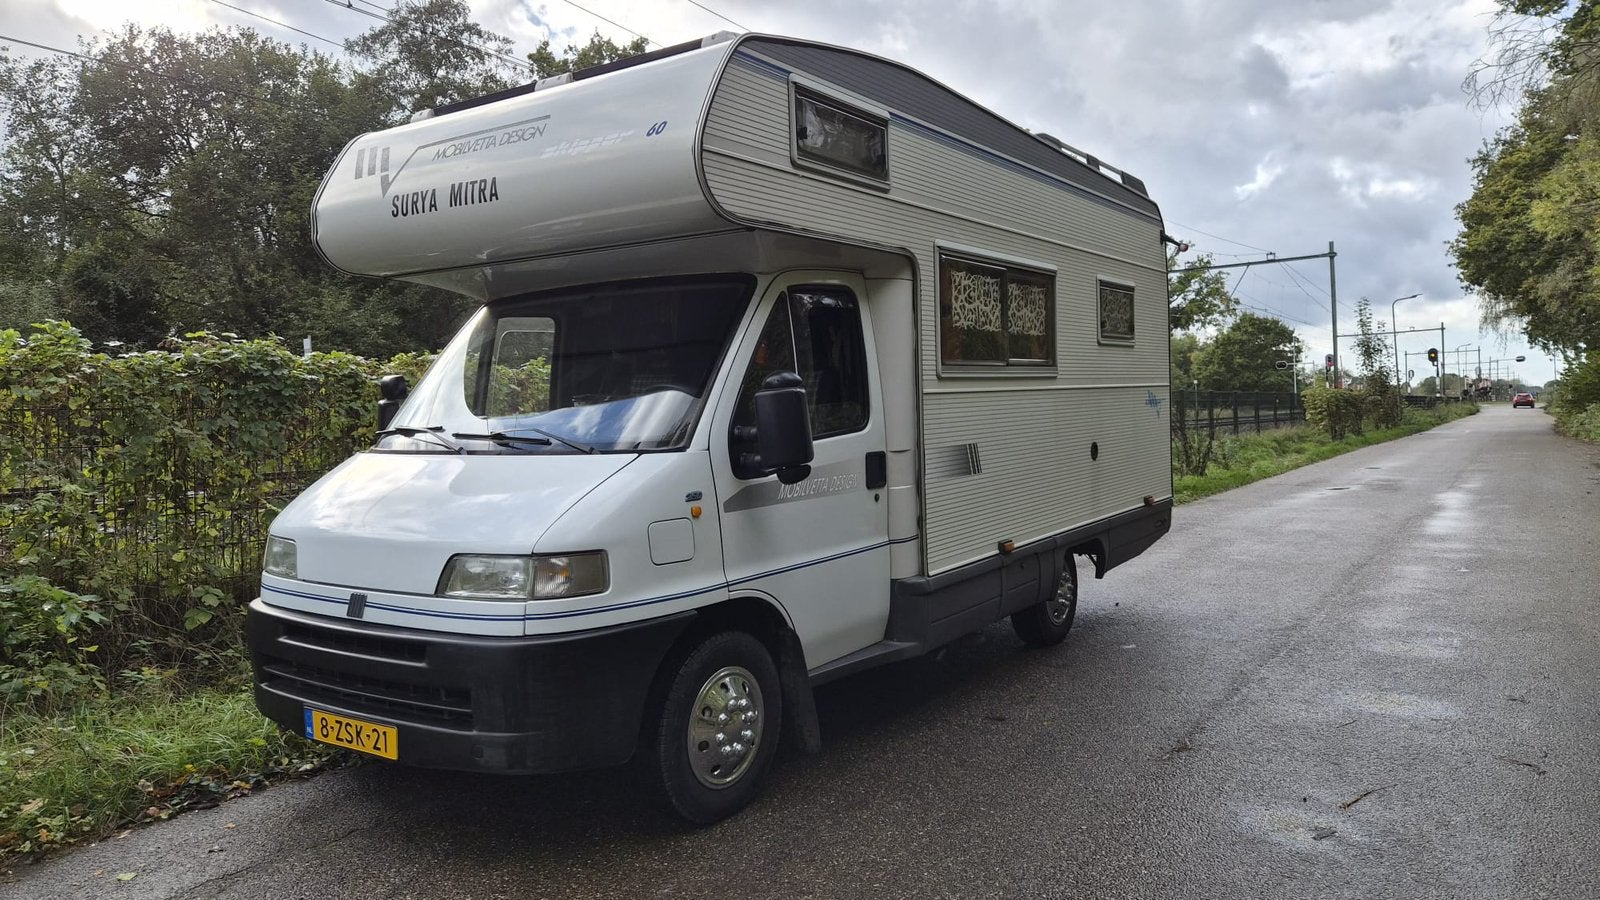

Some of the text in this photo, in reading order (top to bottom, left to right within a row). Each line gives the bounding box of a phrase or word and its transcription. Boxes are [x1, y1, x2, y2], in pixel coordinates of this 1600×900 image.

[432, 123, 547, 162] MOBILVETTA DESIGN
[645, 121, 668, 137] 60
[391, 177, 499, 218] SURYA MITRA
[778, 473, 857, 500] MOBILVETTA DESIGN
[320, 717, 388, 753] 8-ZSK-21
